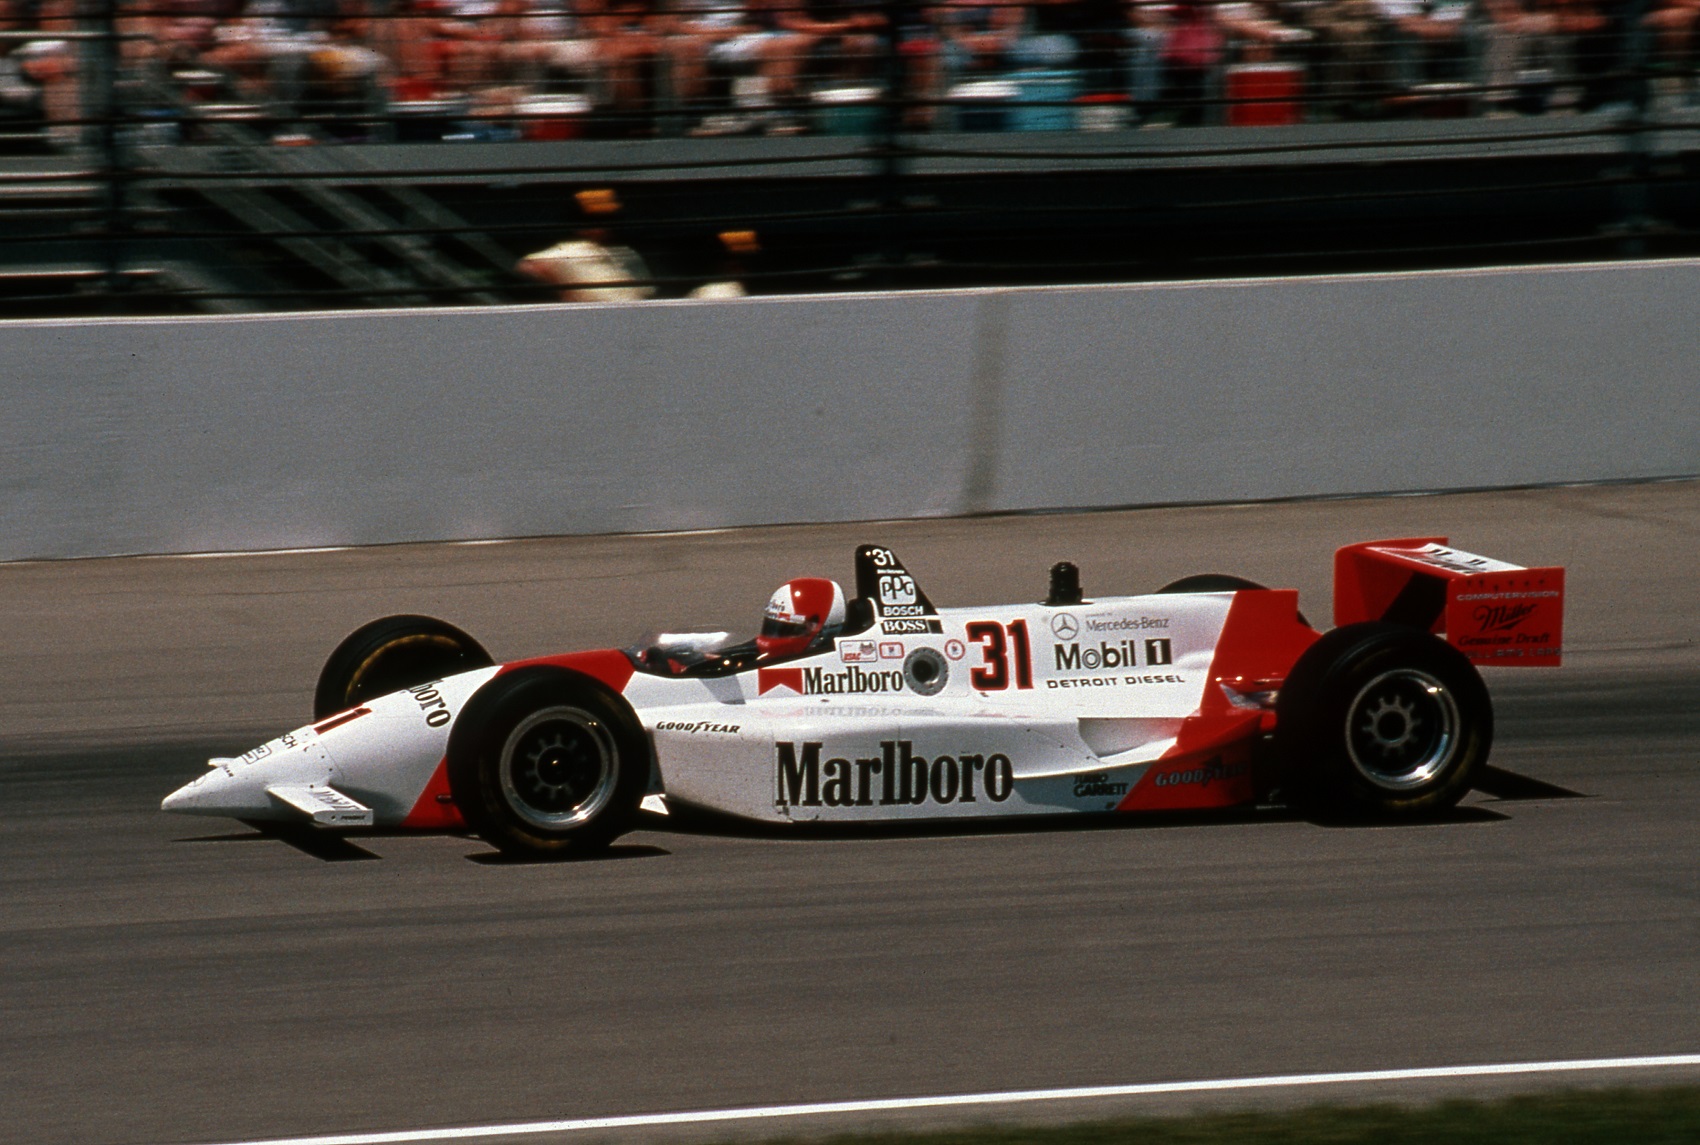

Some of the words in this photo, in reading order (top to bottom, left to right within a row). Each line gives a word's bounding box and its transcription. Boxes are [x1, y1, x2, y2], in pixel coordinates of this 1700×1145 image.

[872, 549, 895, 566] 31
[882, 575, 914, 599] PPG
[883, 606, 923, 616] BOSCH
[1473, 603, 1538, 631] Miller
[884, 620, 926, 632] BOSS
[1086, 616, 1170, 632] Mercedes-Benz
[966, 619, 1033, 691] 31
[1055, 639, 1136, 670] Mobil
[804, 666, 904, 694] Marlboro
[1047, 677, 1117, 689] DETROIT
[1126, 674, 1185, 685] DIESEL
[656, 721, 741, 734] GOODYEAR
[775, 740, 1014, 806] Marlboro
